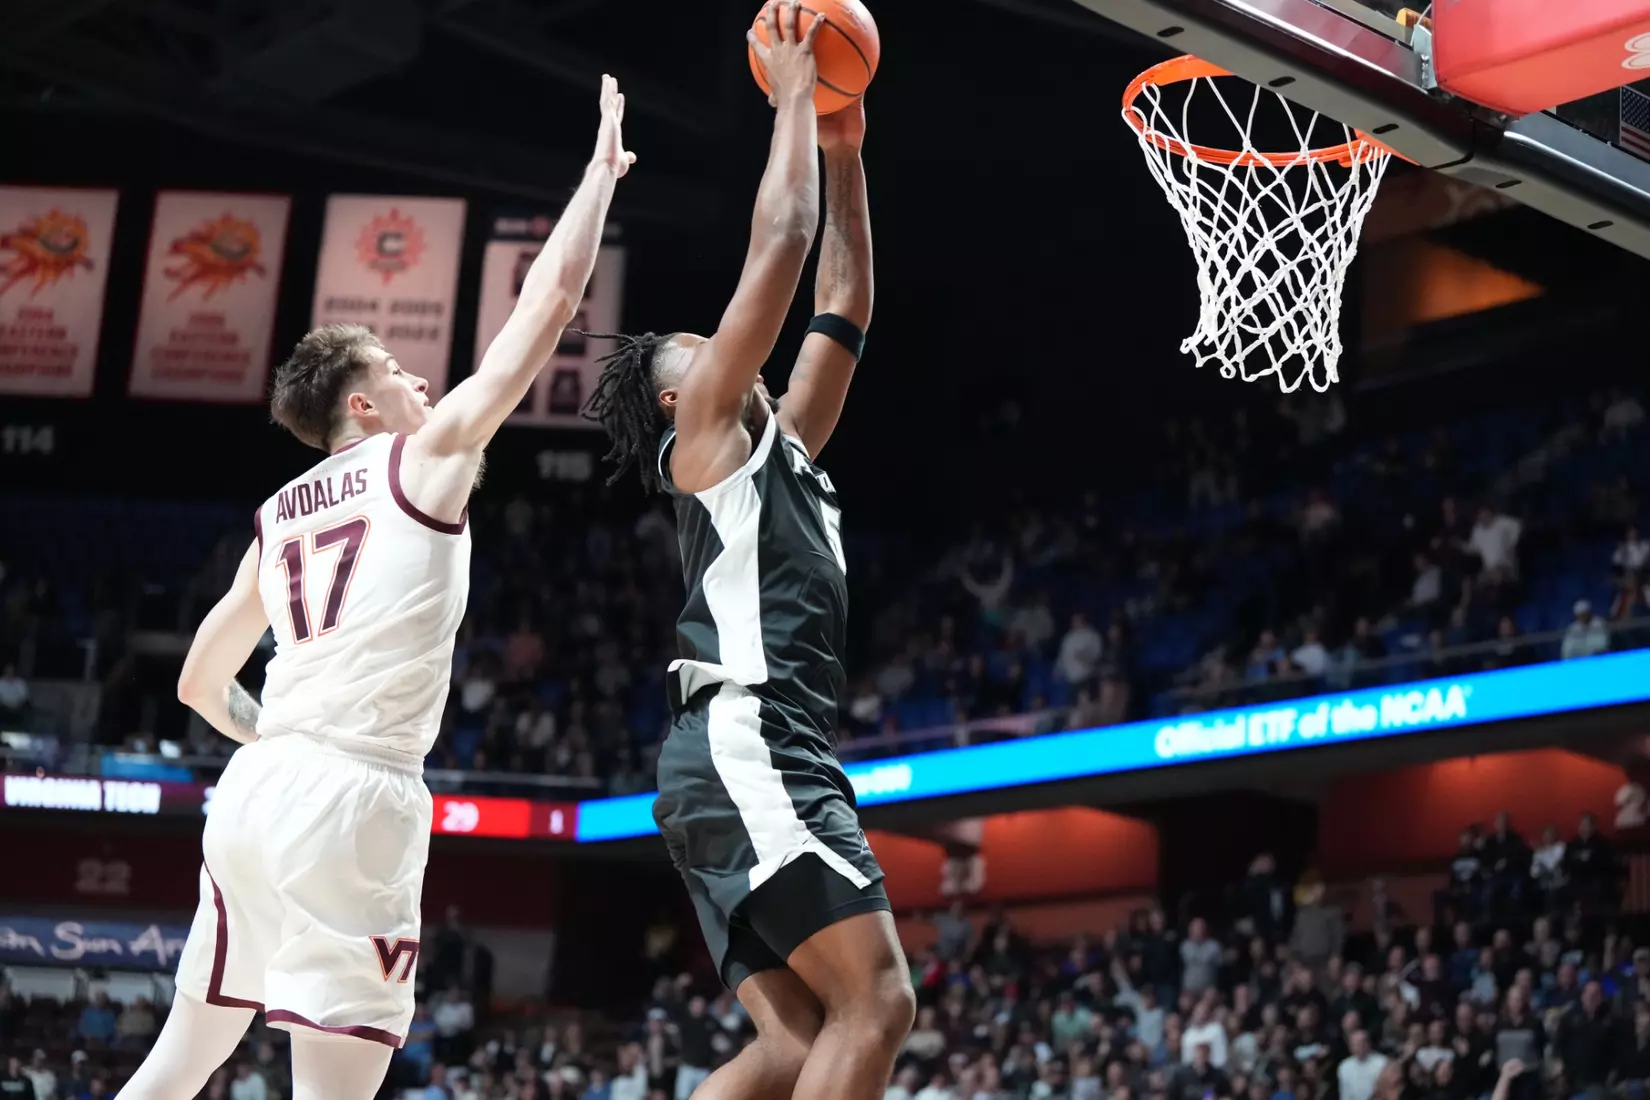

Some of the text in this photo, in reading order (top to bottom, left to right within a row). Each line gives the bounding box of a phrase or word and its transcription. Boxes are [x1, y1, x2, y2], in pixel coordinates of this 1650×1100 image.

[275, 468, 368, 524] AVDALAS
[275, 514, 371, 645] 17
[1248, 708, 1297, 746] ETF
[1298, 703, 1329, 738] of
[1331, 700, 1377, 733] the
[1380, 685, 1466, 727] NCAA
[1613, 781, 1650, 830] 2
